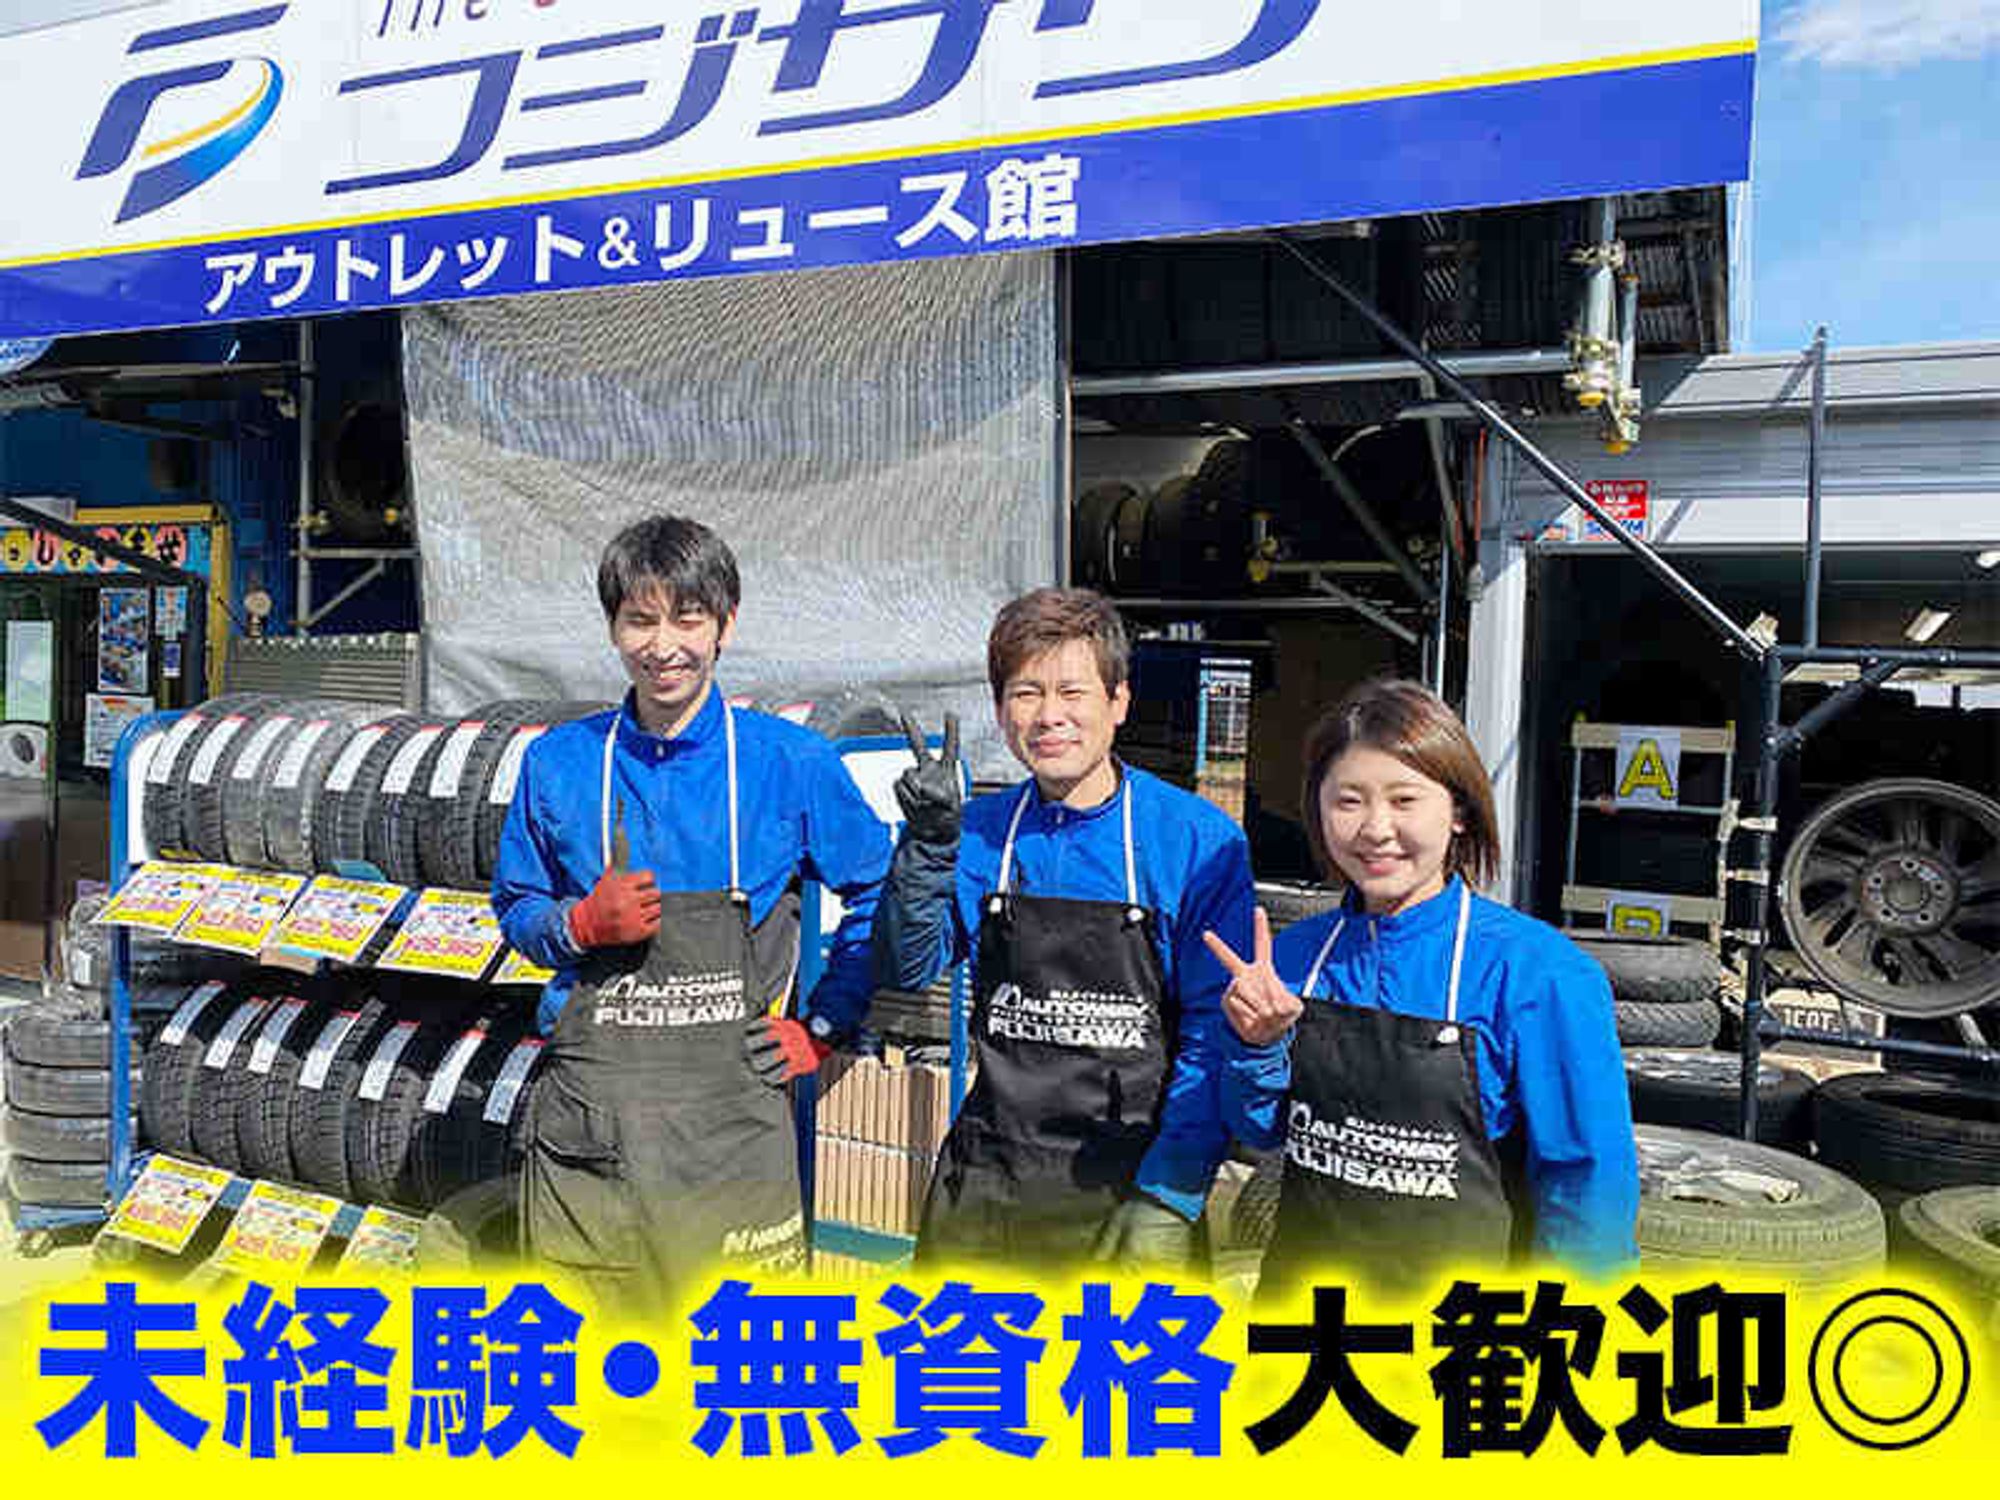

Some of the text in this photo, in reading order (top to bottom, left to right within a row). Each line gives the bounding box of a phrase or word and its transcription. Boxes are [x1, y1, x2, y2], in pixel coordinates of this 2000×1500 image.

[1619, 738, 1674, 799] A
[595, 1002, 746, 1027] FUJISAWA
[987, 1016, 1146, 1049] FUJISAWA
